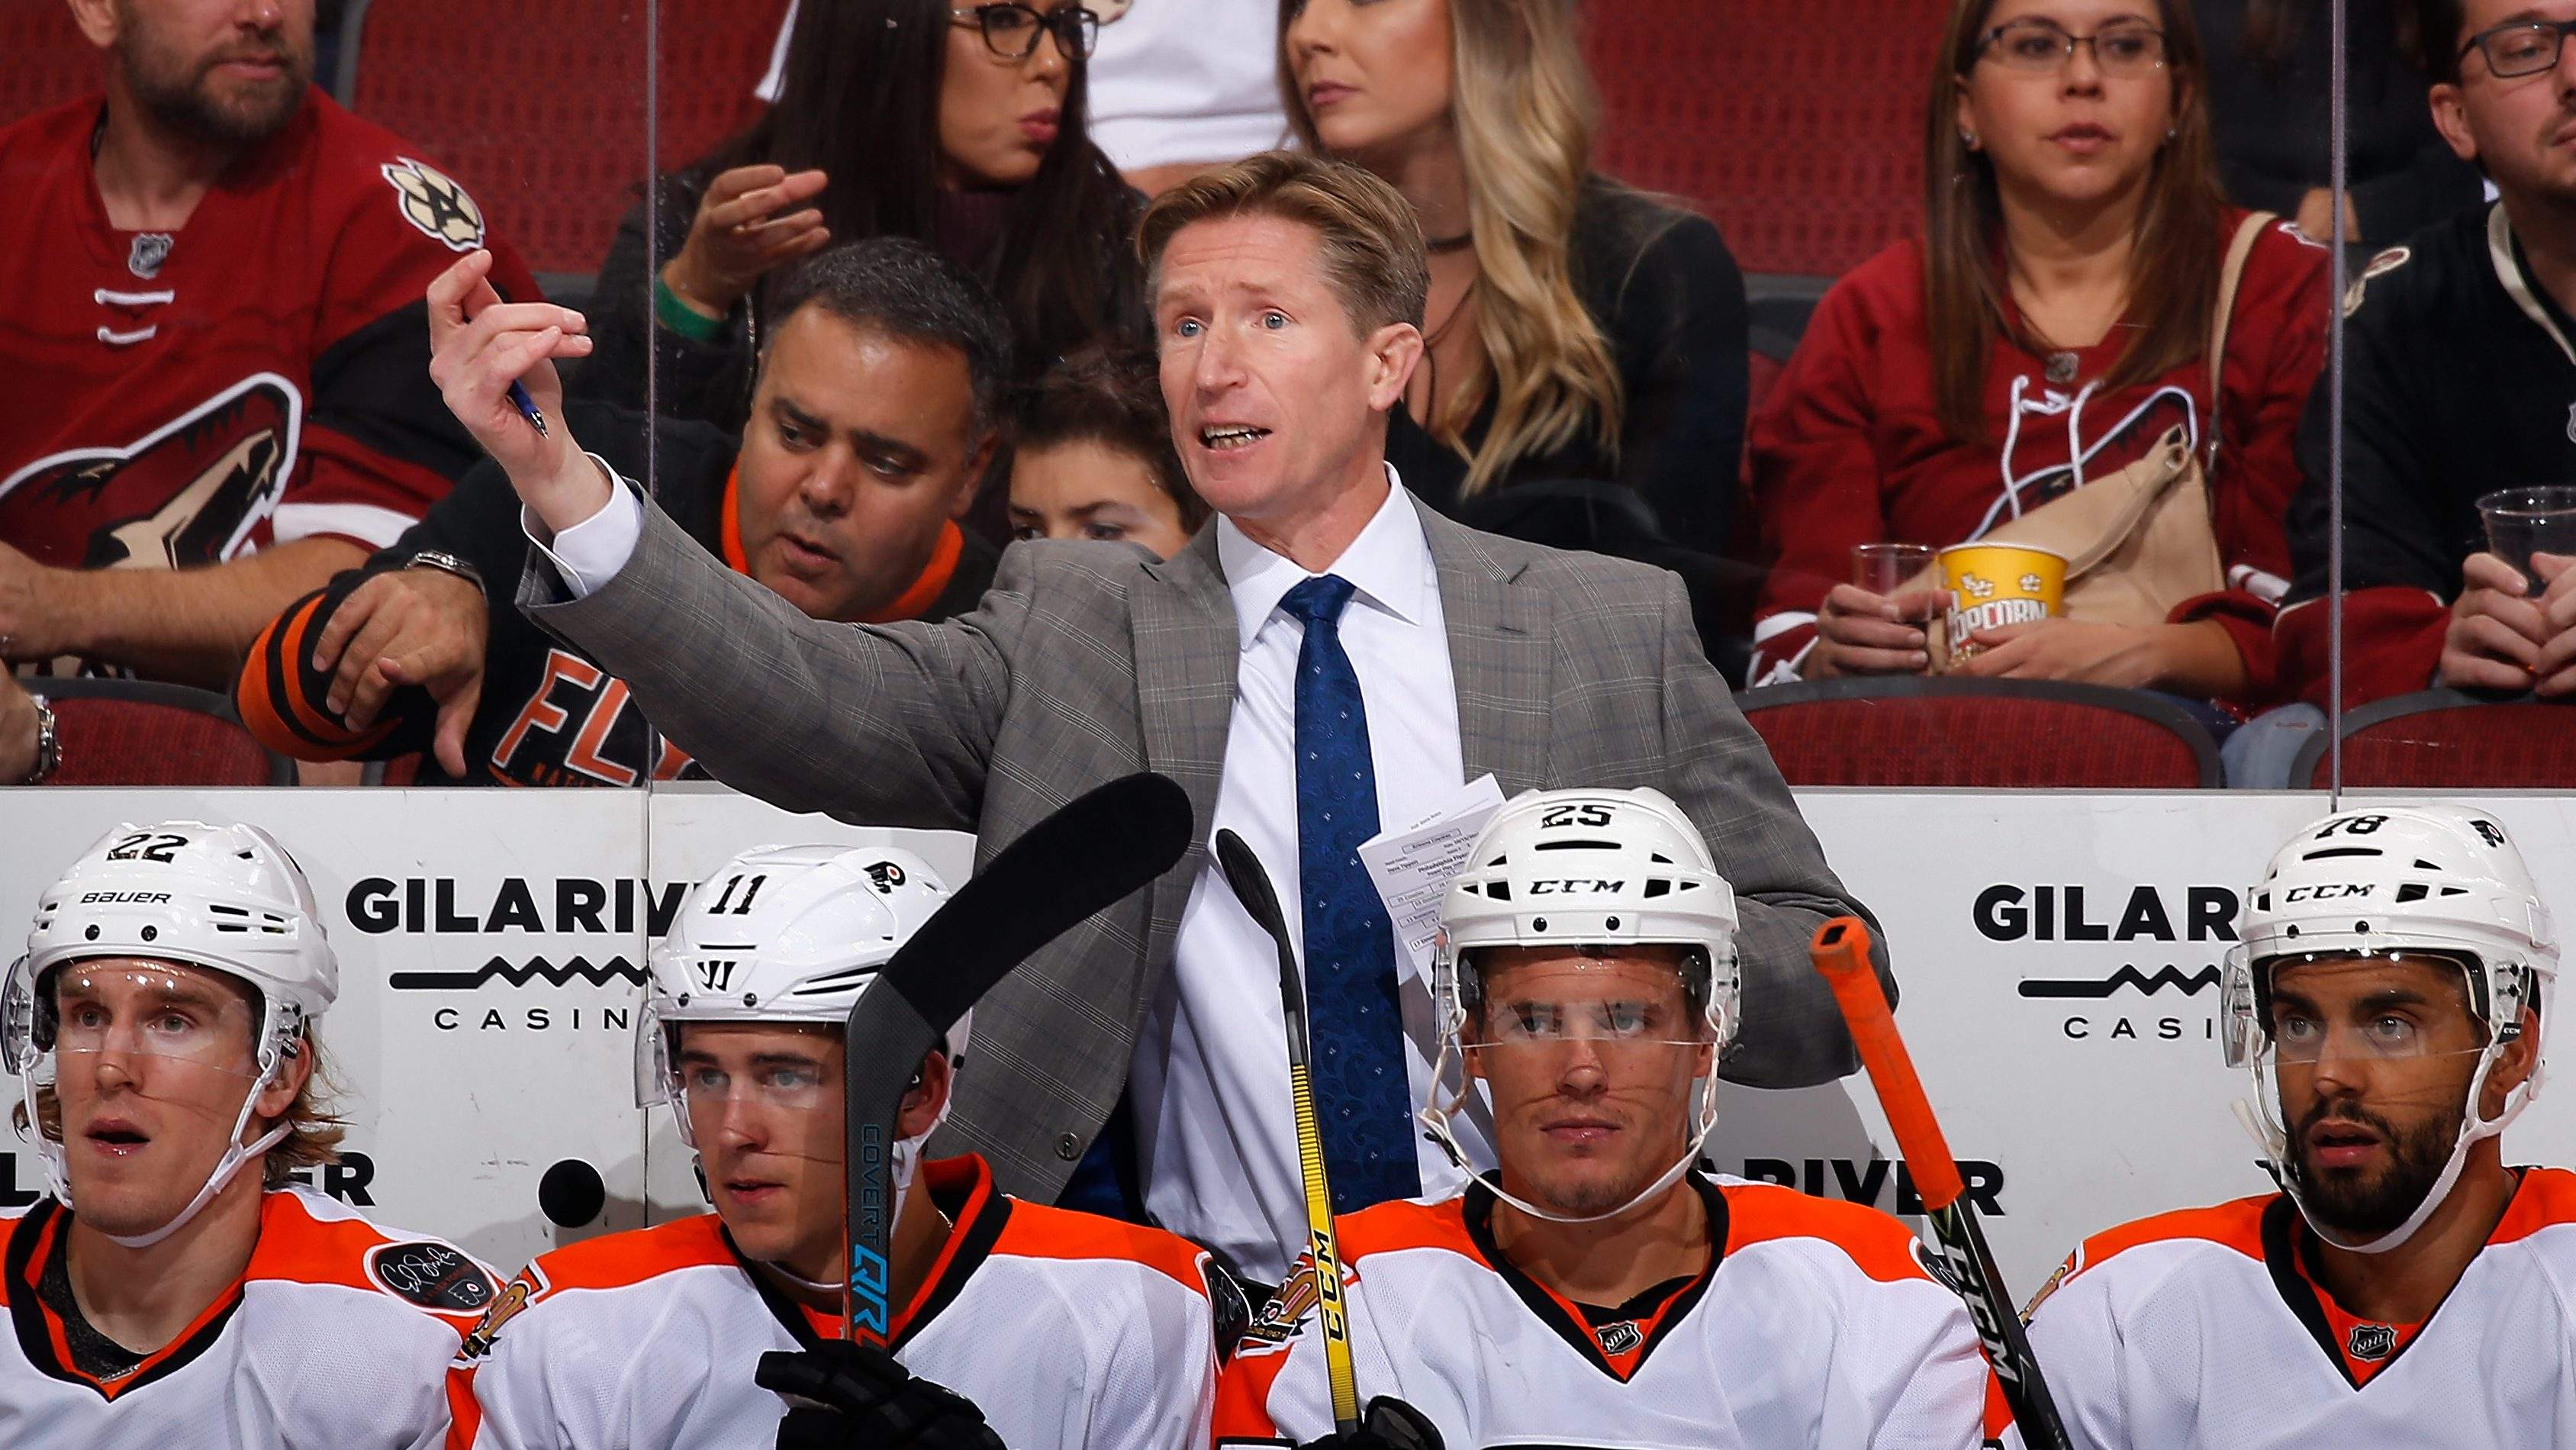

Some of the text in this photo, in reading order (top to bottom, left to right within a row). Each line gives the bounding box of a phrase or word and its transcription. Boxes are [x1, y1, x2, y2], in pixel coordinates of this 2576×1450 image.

[1541, 805, 1616, 828] 25
[2314, 815, 2390, 839] 78
[106, 833, 189, 864] 22
[80, 891, 172, 904] BAUER
[708, 875, 768, 915] 11
[1530, 880, 1624, 895] CCM
[2286, 884, 2375, 903] CCM
[434, 1008, 628, 1030] CASIN
[2064, 1017, 2212, 1039] CASI
[862, 1124, 880, 1246] COVERT
[1313, 1229, 1344, 1342] CCM
[1944, 1244, 2019, 1382] CCM
